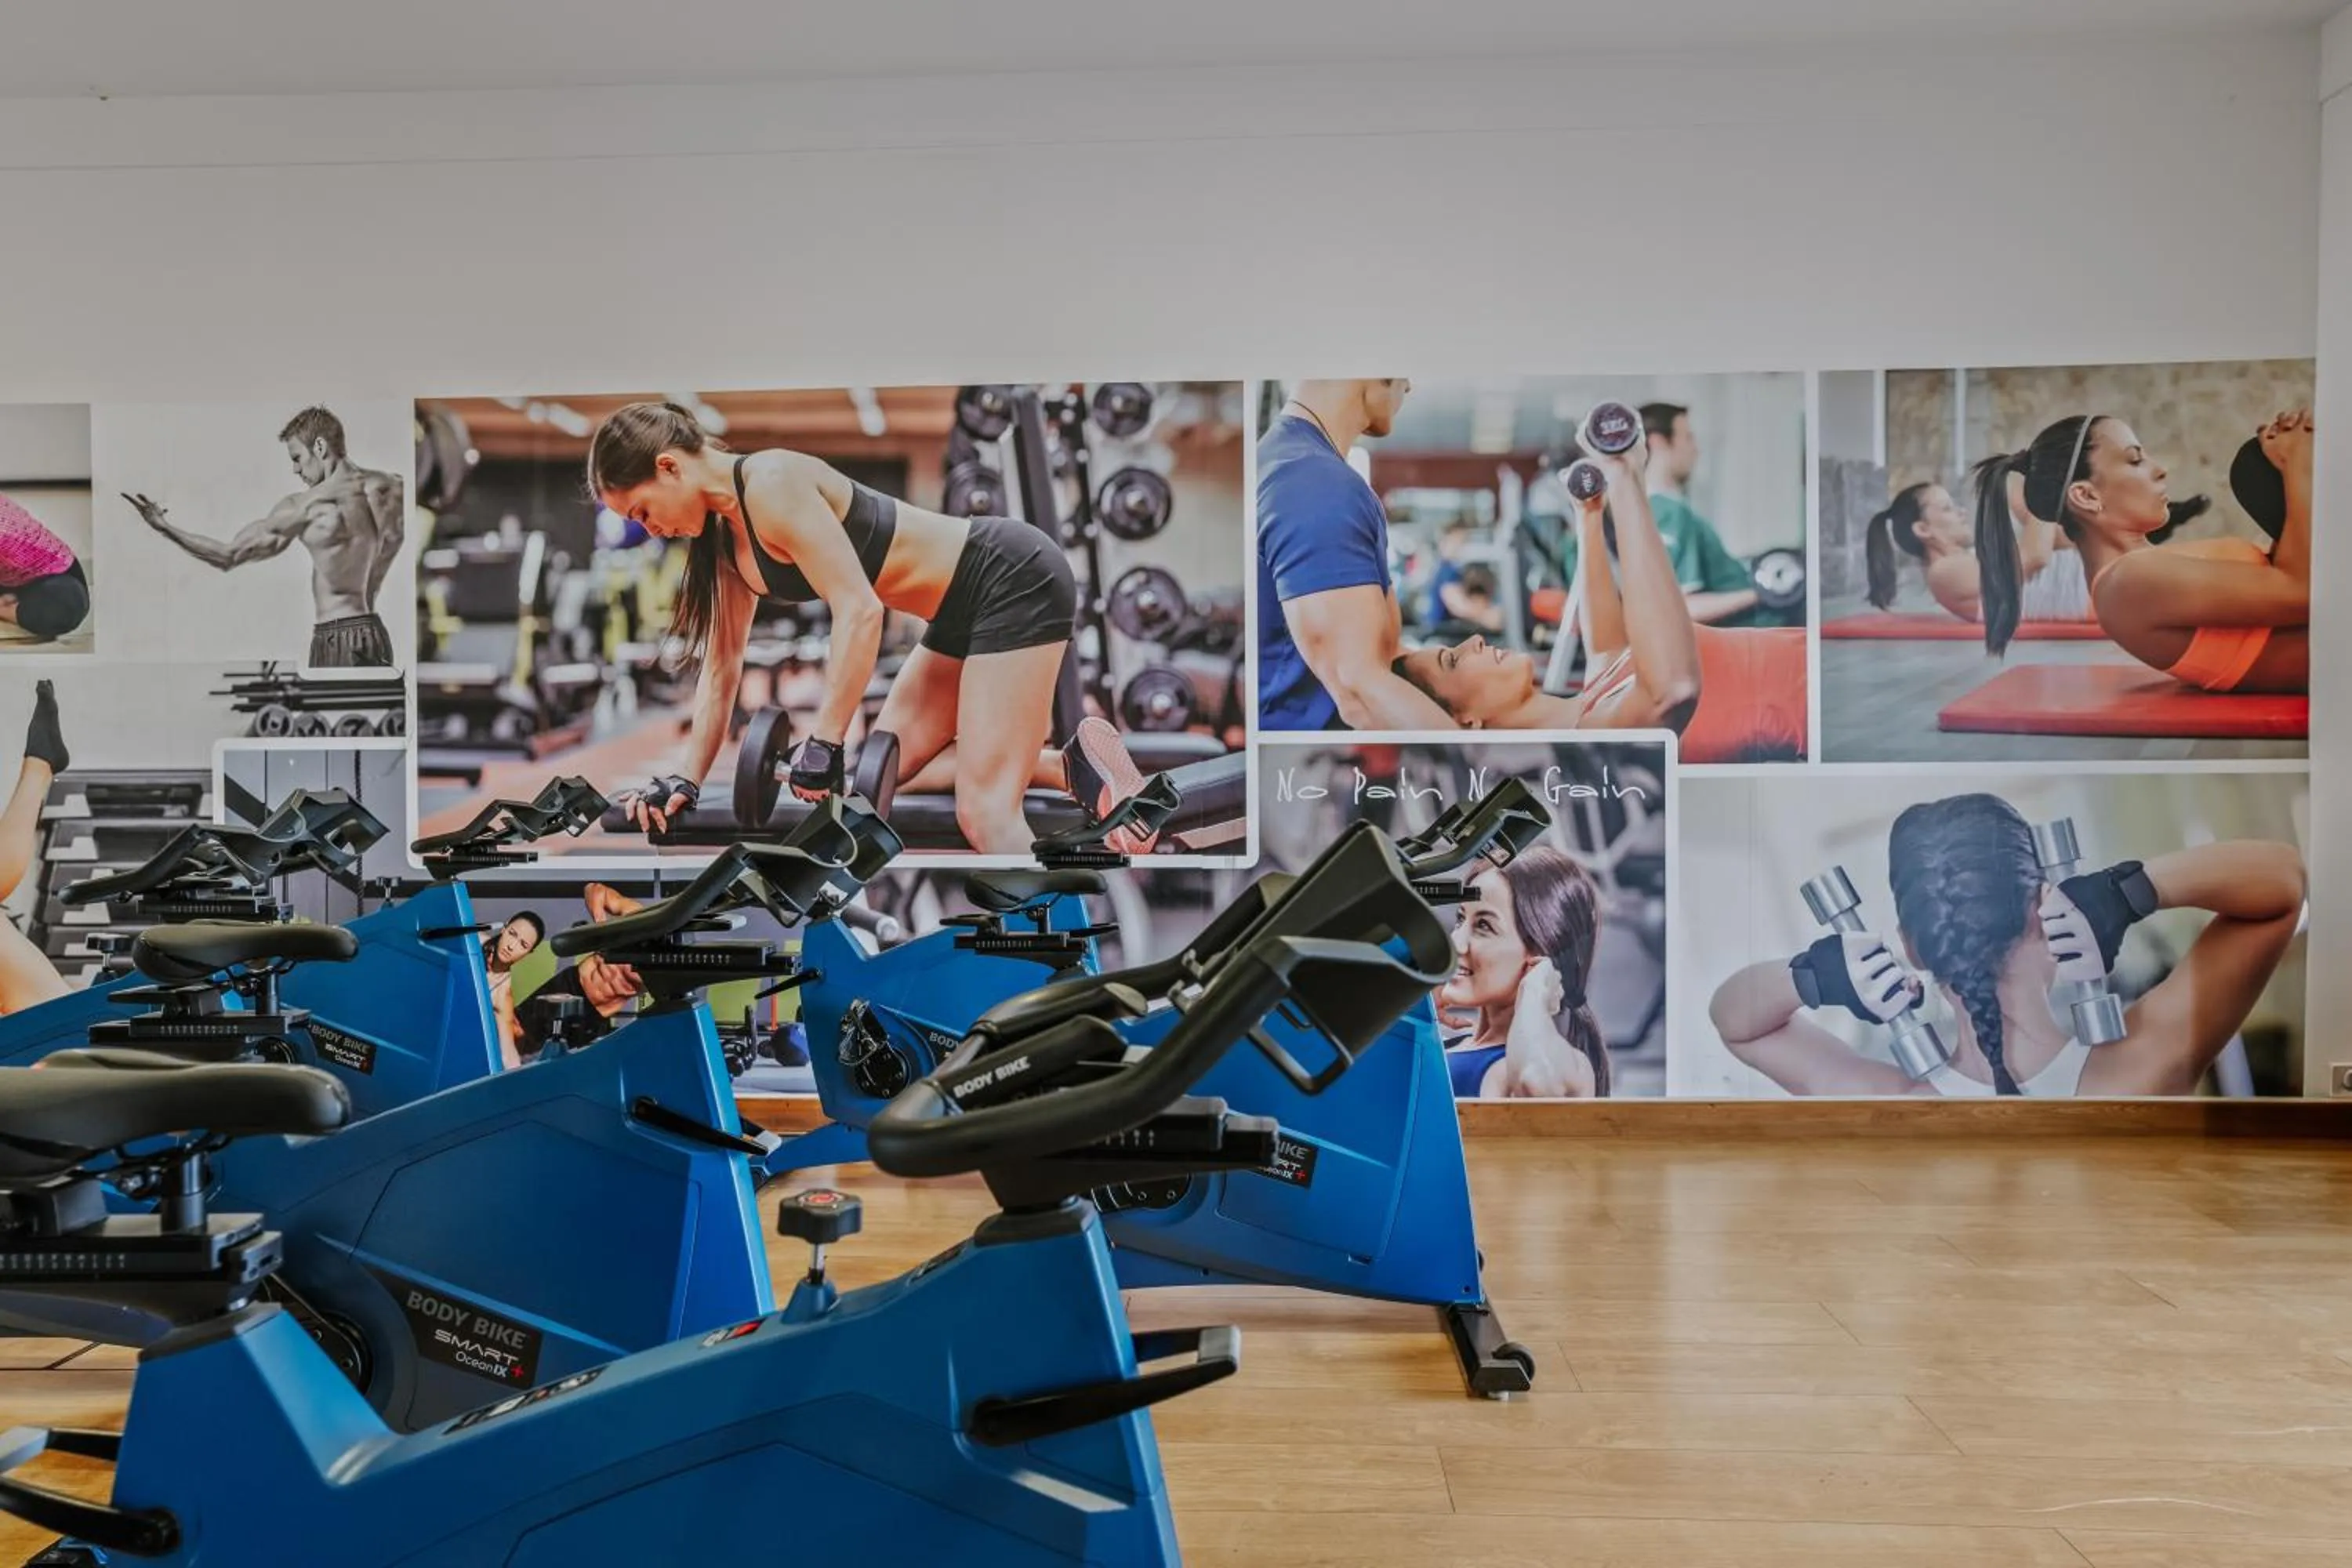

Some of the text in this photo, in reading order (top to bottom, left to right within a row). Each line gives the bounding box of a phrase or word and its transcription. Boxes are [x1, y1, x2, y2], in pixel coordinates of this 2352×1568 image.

[1276, 766, 1329, 804] No
[1353, 765, 1443, 805] Pain
[1543, 764, 1646, 805] Gain
[953, 1055, 1032, 1098] BODY BIKE
[1279, 1141, 1308, 1160] IKE
[406, 1290, 528, 1350] BODY BIKE
[434, 1328, 520, 1365] SMART
